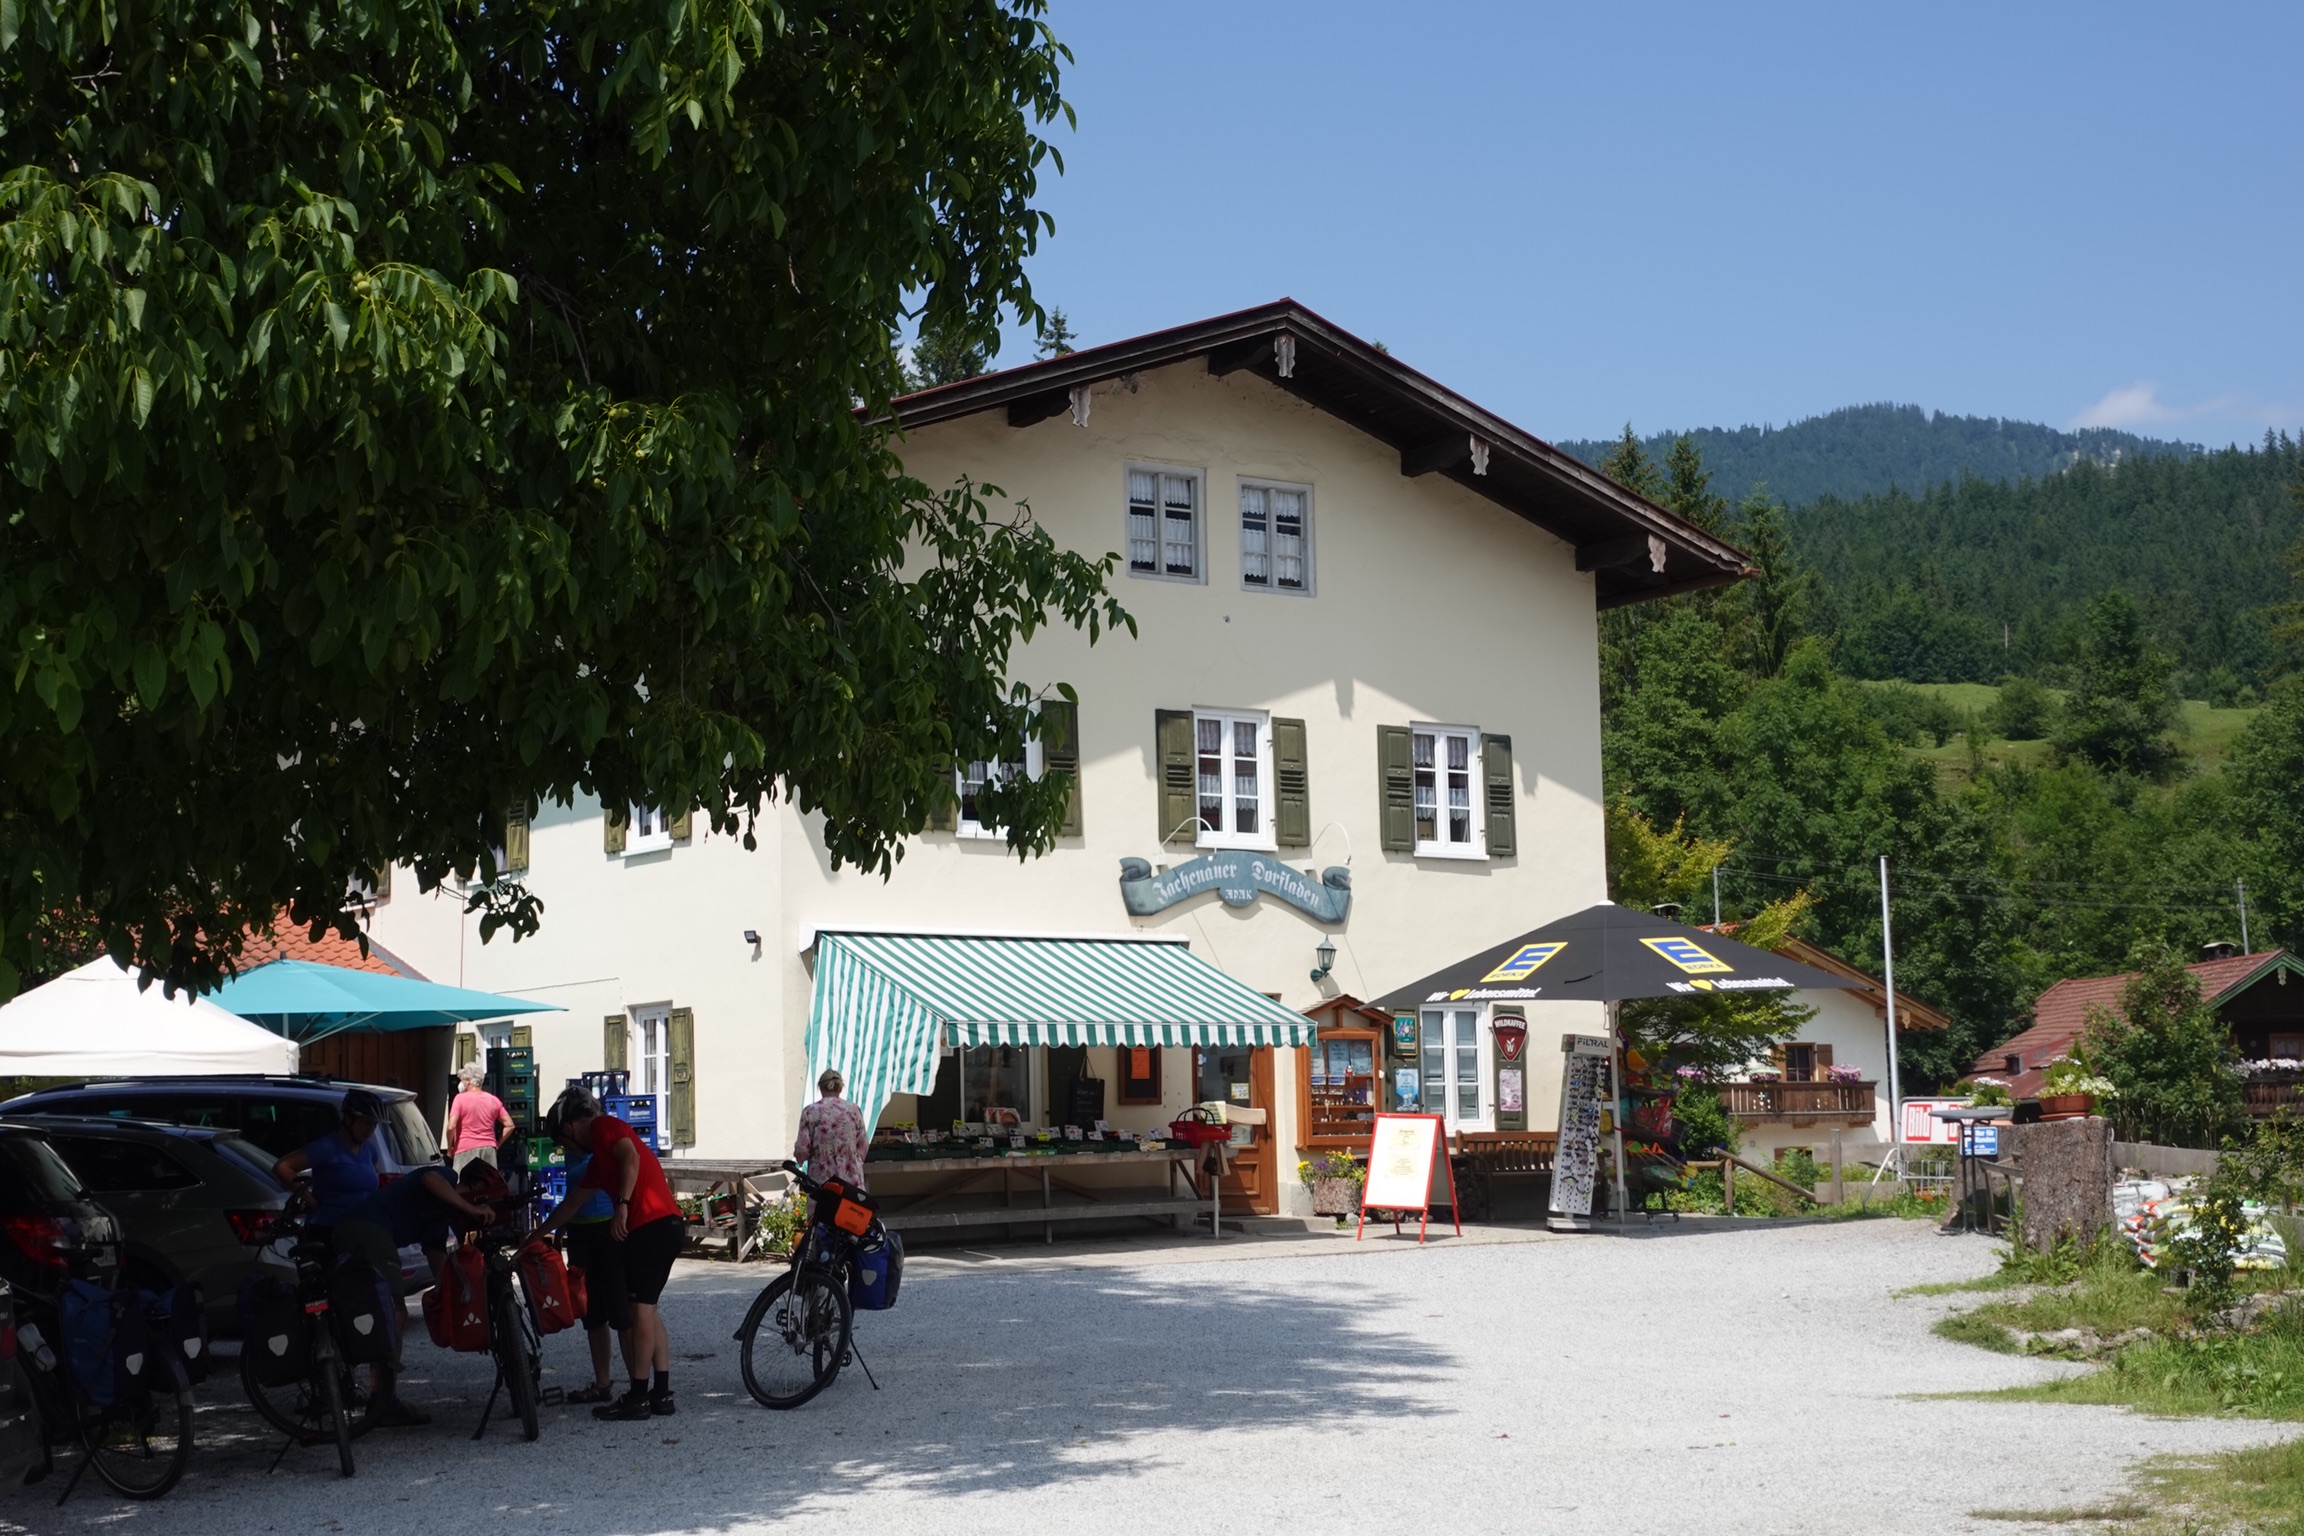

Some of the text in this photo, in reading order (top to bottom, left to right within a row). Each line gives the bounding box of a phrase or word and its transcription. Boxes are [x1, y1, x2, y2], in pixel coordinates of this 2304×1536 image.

[1152, 861, 1320, 908] Jachenauer Dorfladen
[1490, 971, 1526, 979] EDEKA
[1666, 981, 1696, 993] Wir
[1425, 991, 1450, 1002] Wir
[1494, 1018, 1526, 1030] WILDKAFFEE
[1908, 1106, 1931, 1137] Bild
